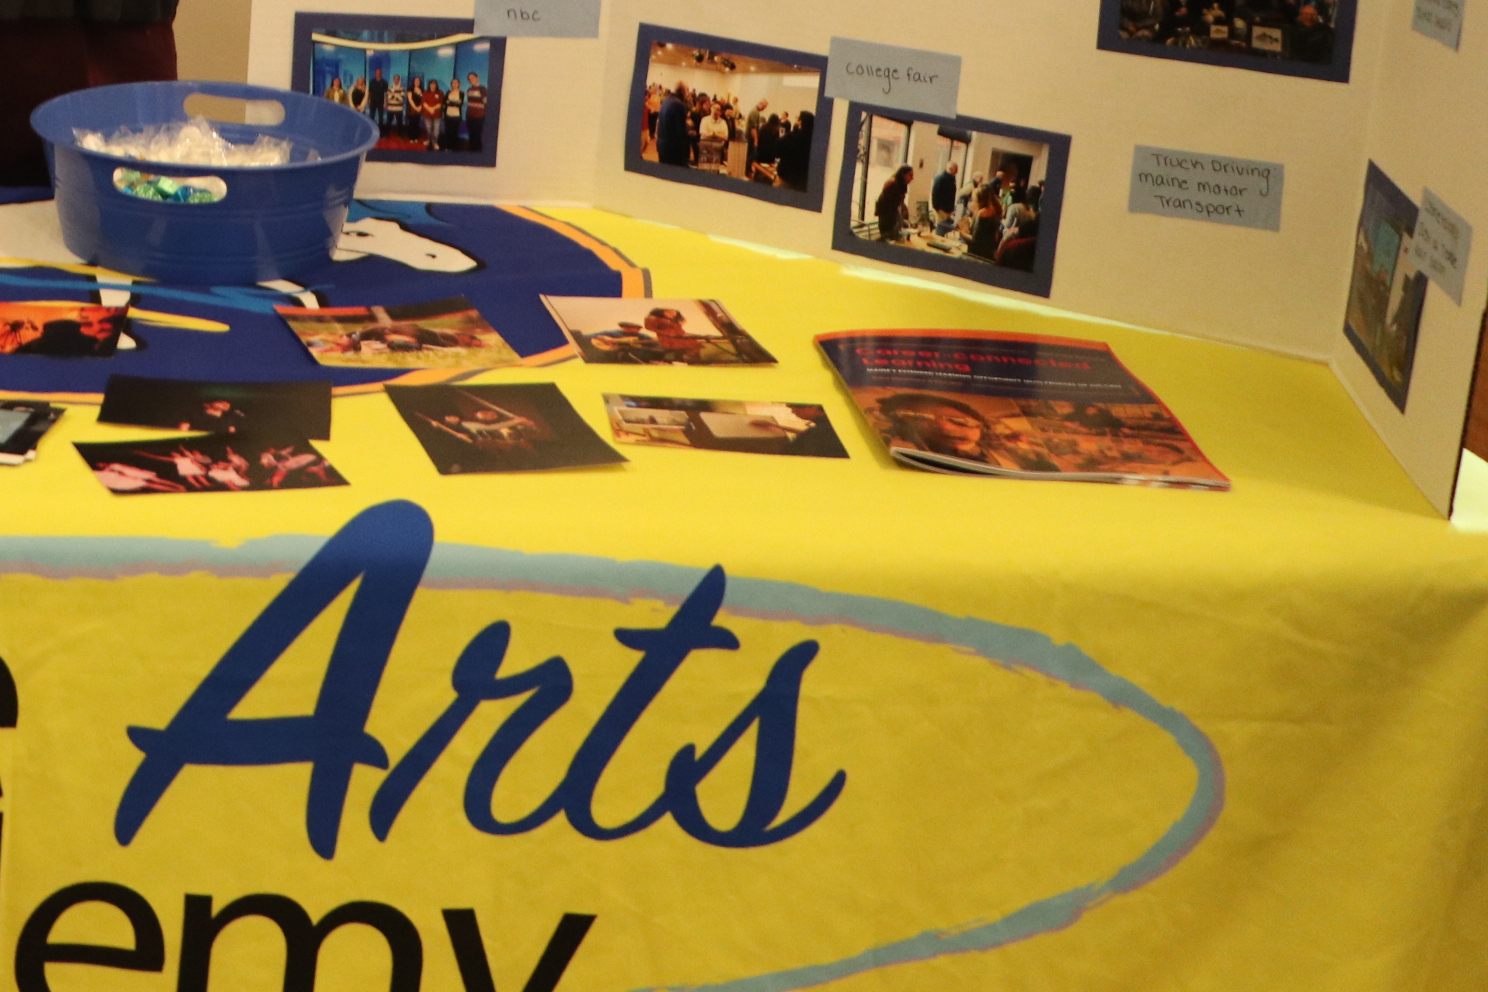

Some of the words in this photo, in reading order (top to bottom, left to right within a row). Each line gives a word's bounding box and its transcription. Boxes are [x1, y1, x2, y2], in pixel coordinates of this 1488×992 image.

[507, 8, 541, 22] nbc
[846, 62, 899, 94] college
[906, 68, 939, 85] fair
[1139, 172, 1190, 190] maine
[1197, 181, 1248, 196] motor
[113, 498, 847, 862] Arts
